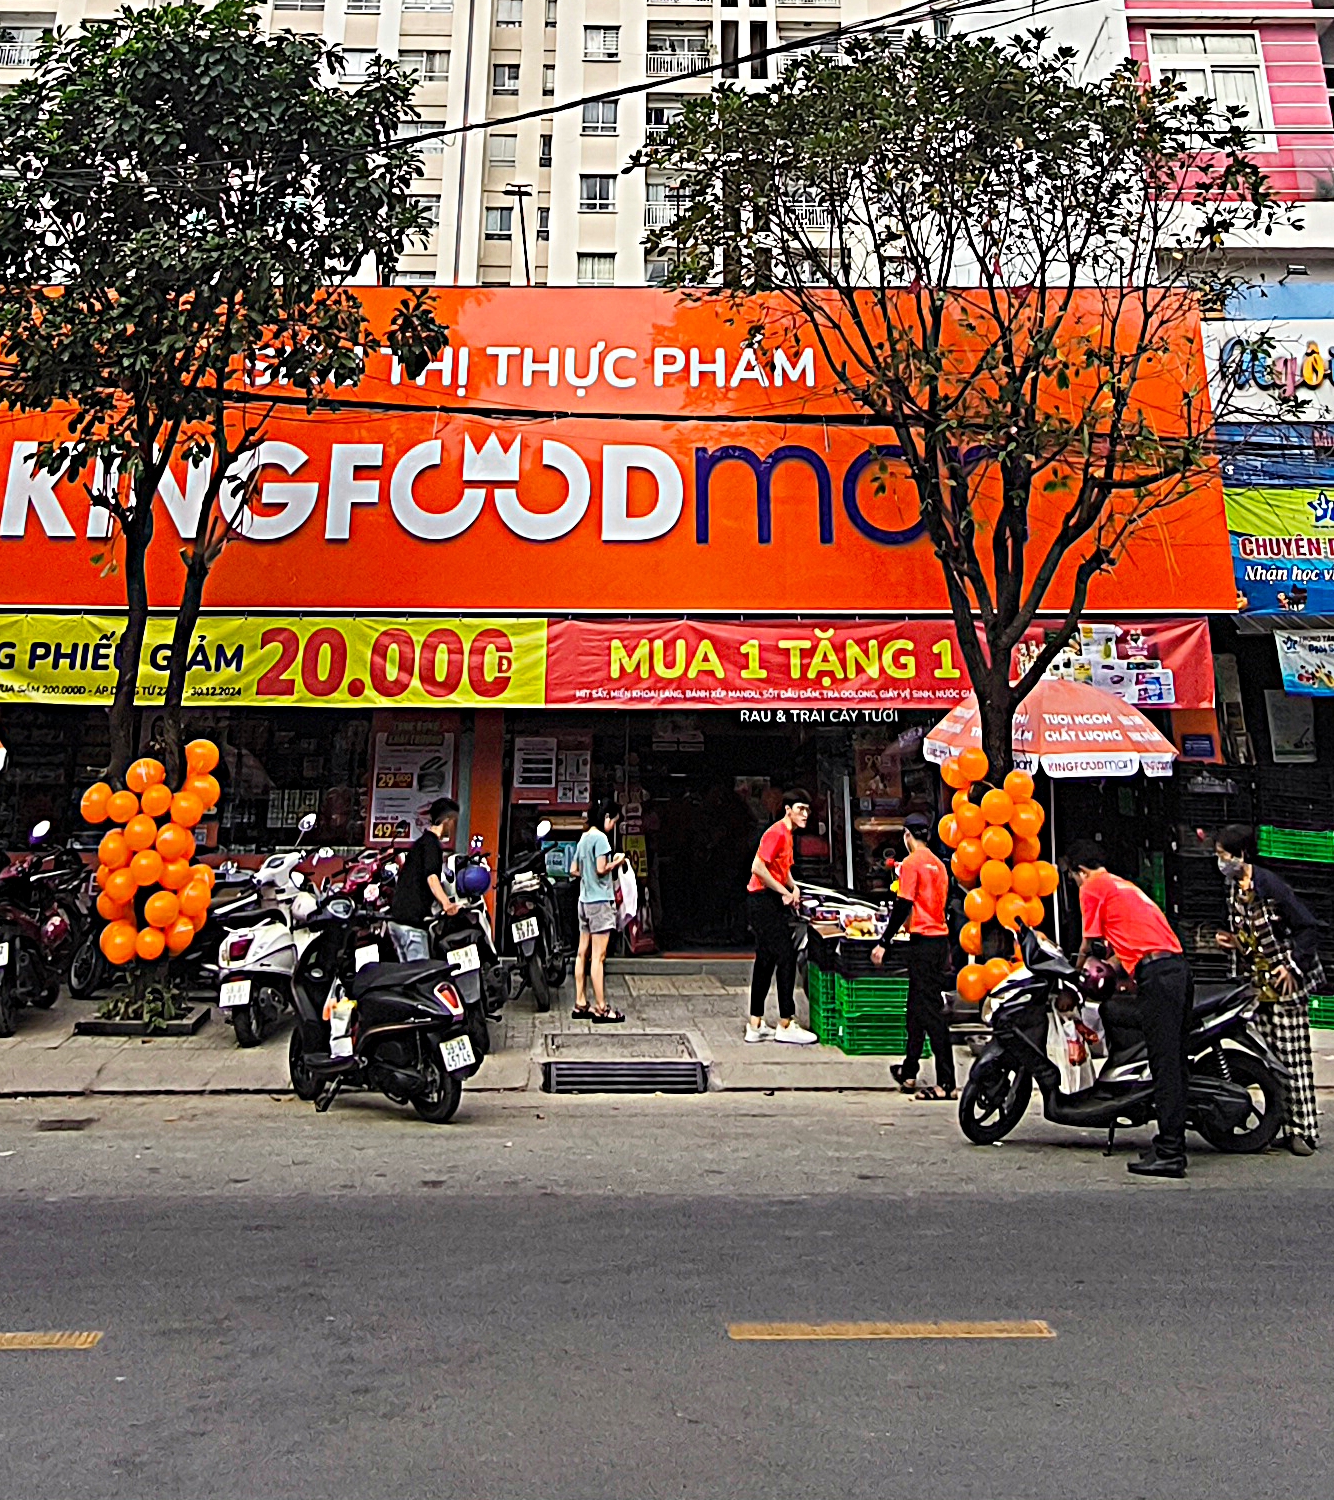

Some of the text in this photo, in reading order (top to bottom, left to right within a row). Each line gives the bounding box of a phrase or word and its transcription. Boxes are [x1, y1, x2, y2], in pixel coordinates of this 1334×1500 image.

[486, 340, 638, 403] THỰC
[1238, 533, 1323, 558] CHUYÊN
[1244, 564, 1287, 583] Nhận
[1292, 566, 1319, 584] học
[28, 630, 123, 672] PHIẾ
[149, 634, 245, 674] GẢM
[609, 627, 961, 687] MUA 1 TẶNG 1
[740, 707, 898, 722] RAU & TRÁI CÂY TƯƠI
[1075, 713, 1113, 725] NGON
